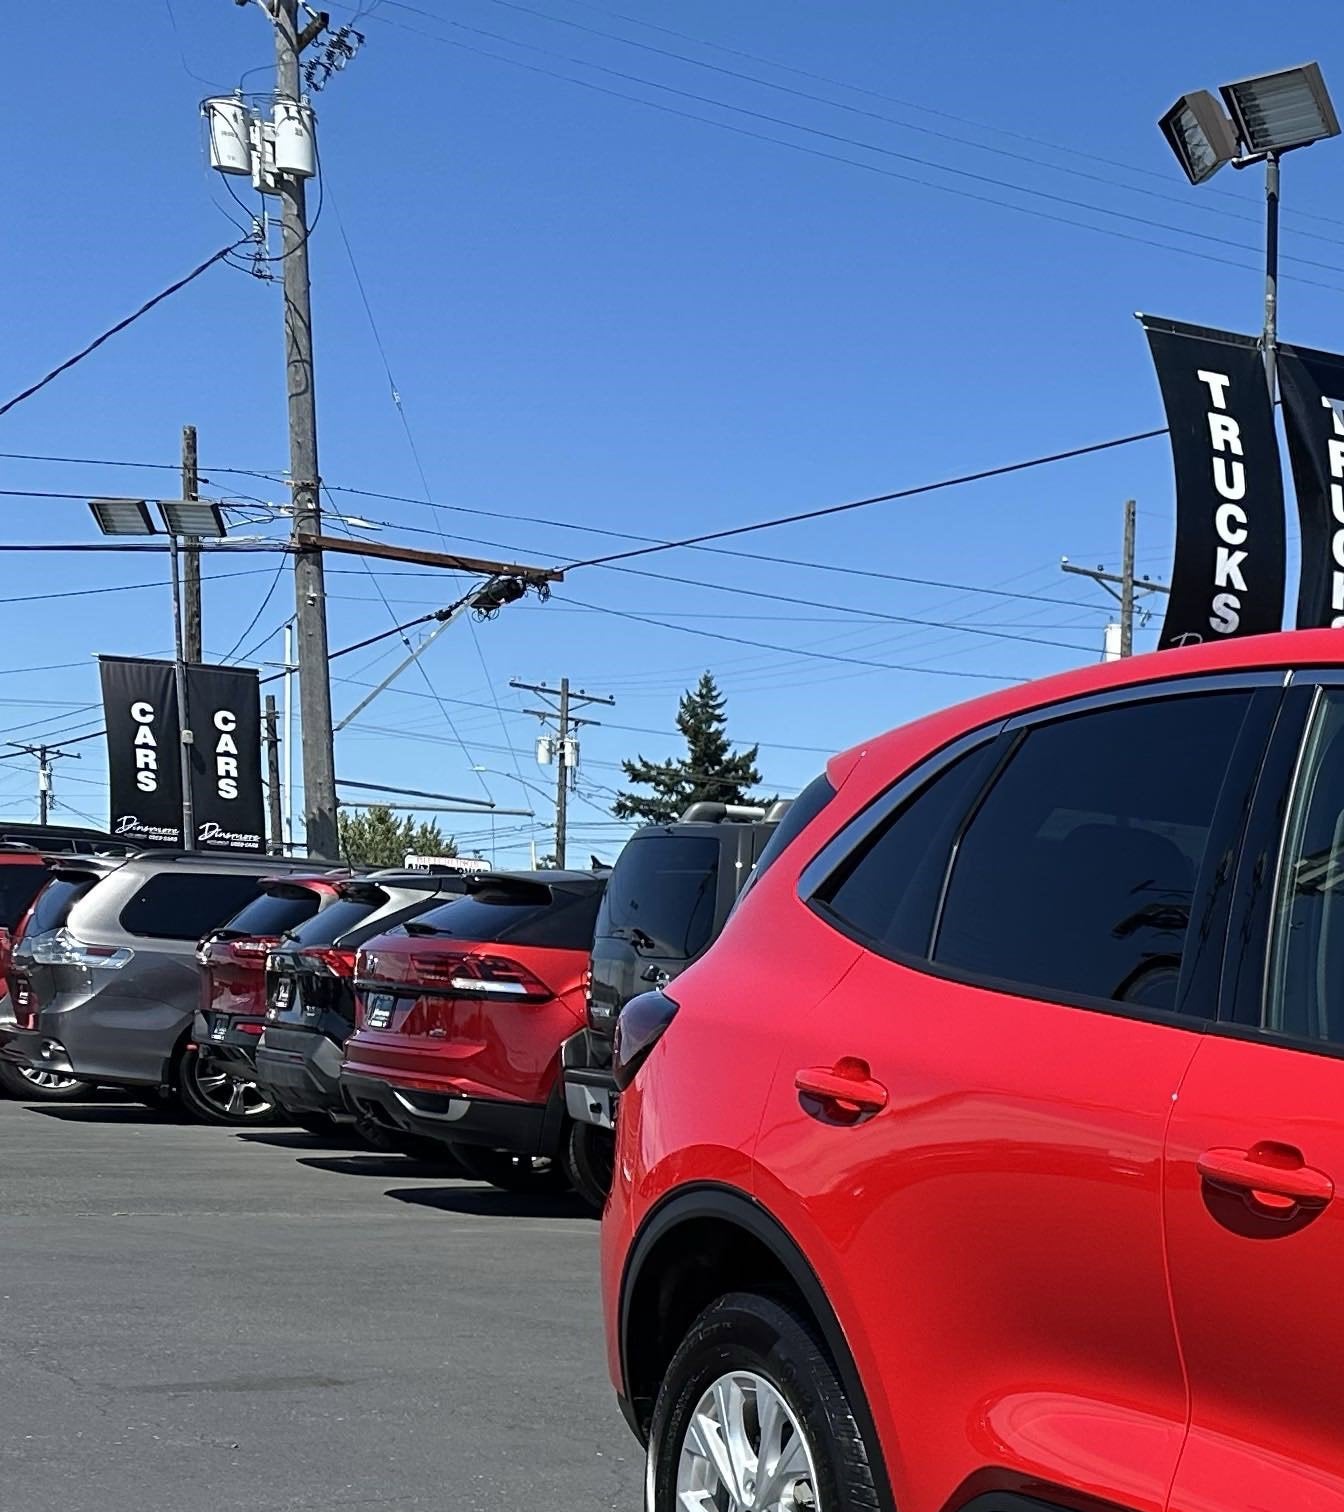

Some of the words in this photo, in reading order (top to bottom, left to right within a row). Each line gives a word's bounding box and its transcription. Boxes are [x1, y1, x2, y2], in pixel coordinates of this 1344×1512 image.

[1197, 369, 1249, 634] TRUCKS
[131, 701, 158, 792] CARS
[213, 710, 239, 799] CARS
